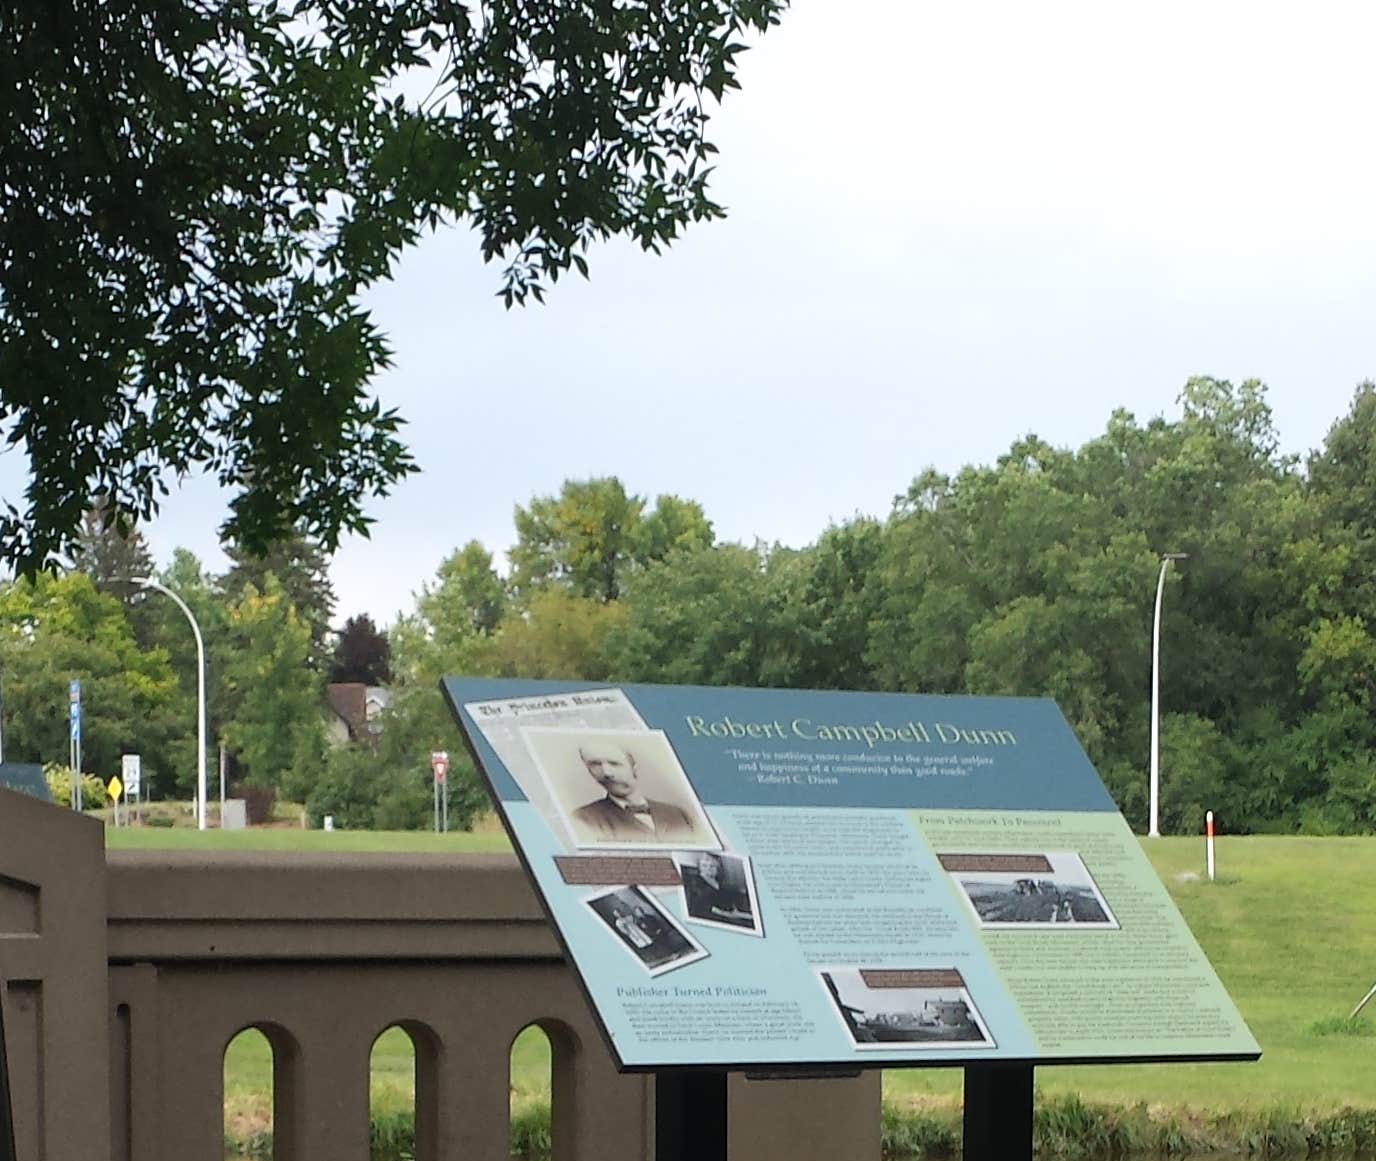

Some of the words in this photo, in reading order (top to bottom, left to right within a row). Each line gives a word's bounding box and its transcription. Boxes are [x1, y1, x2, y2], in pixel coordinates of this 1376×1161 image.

[685, 715, 788, 739] Robert
[791, 718, 930, 749] Campbell
[935, 722, 1017, 745] Dunn
[616, 986, 668, 997] Publisher
[672, 986, 712, 997] Turned
[714, 986, 767, 997] Politician
